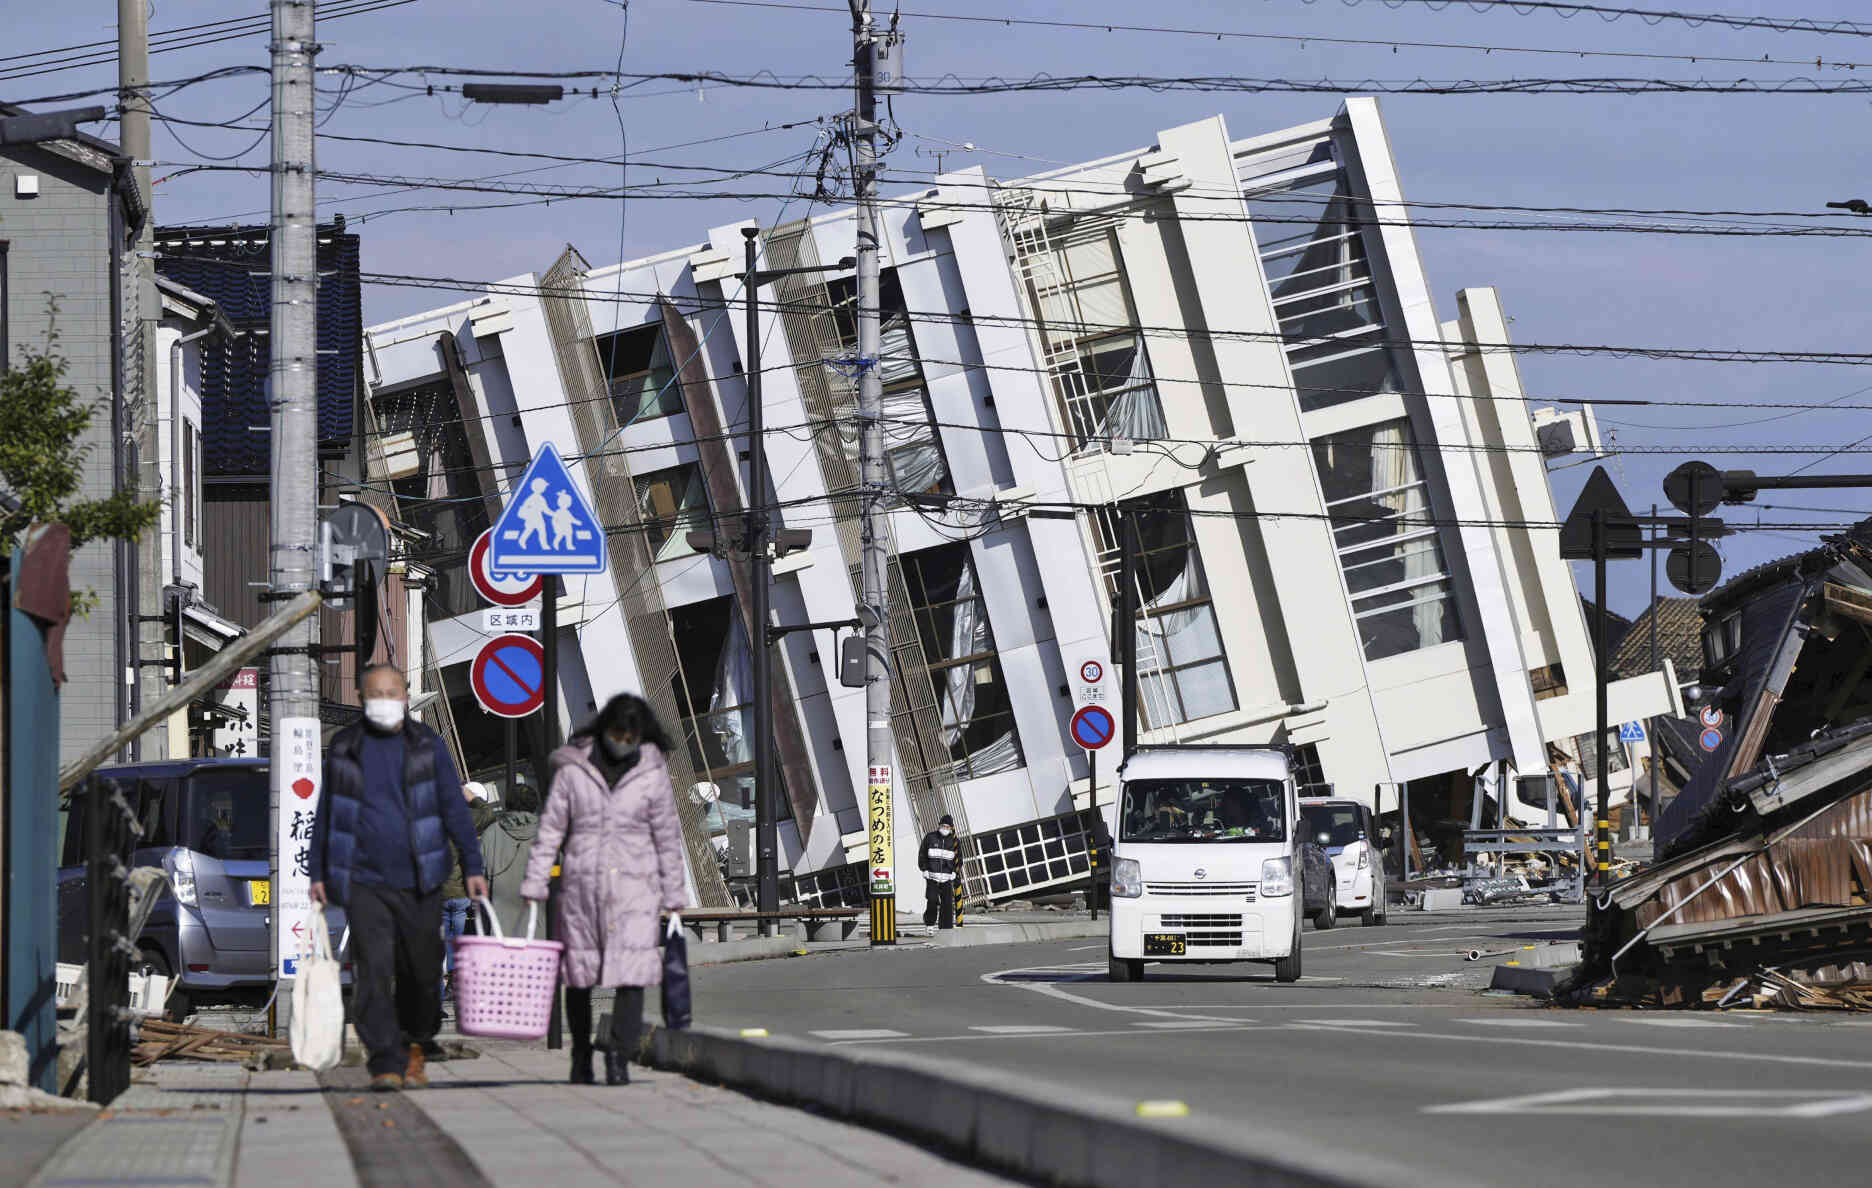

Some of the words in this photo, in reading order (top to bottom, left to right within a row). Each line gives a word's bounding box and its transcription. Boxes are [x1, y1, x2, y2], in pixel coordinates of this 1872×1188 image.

[490, 614, 533, 626] 区域内
[1085, 666, 1099, 678] 30
[871, 788, 885, 864] なつめの店
[1170, 941, 1185, 953] 23
